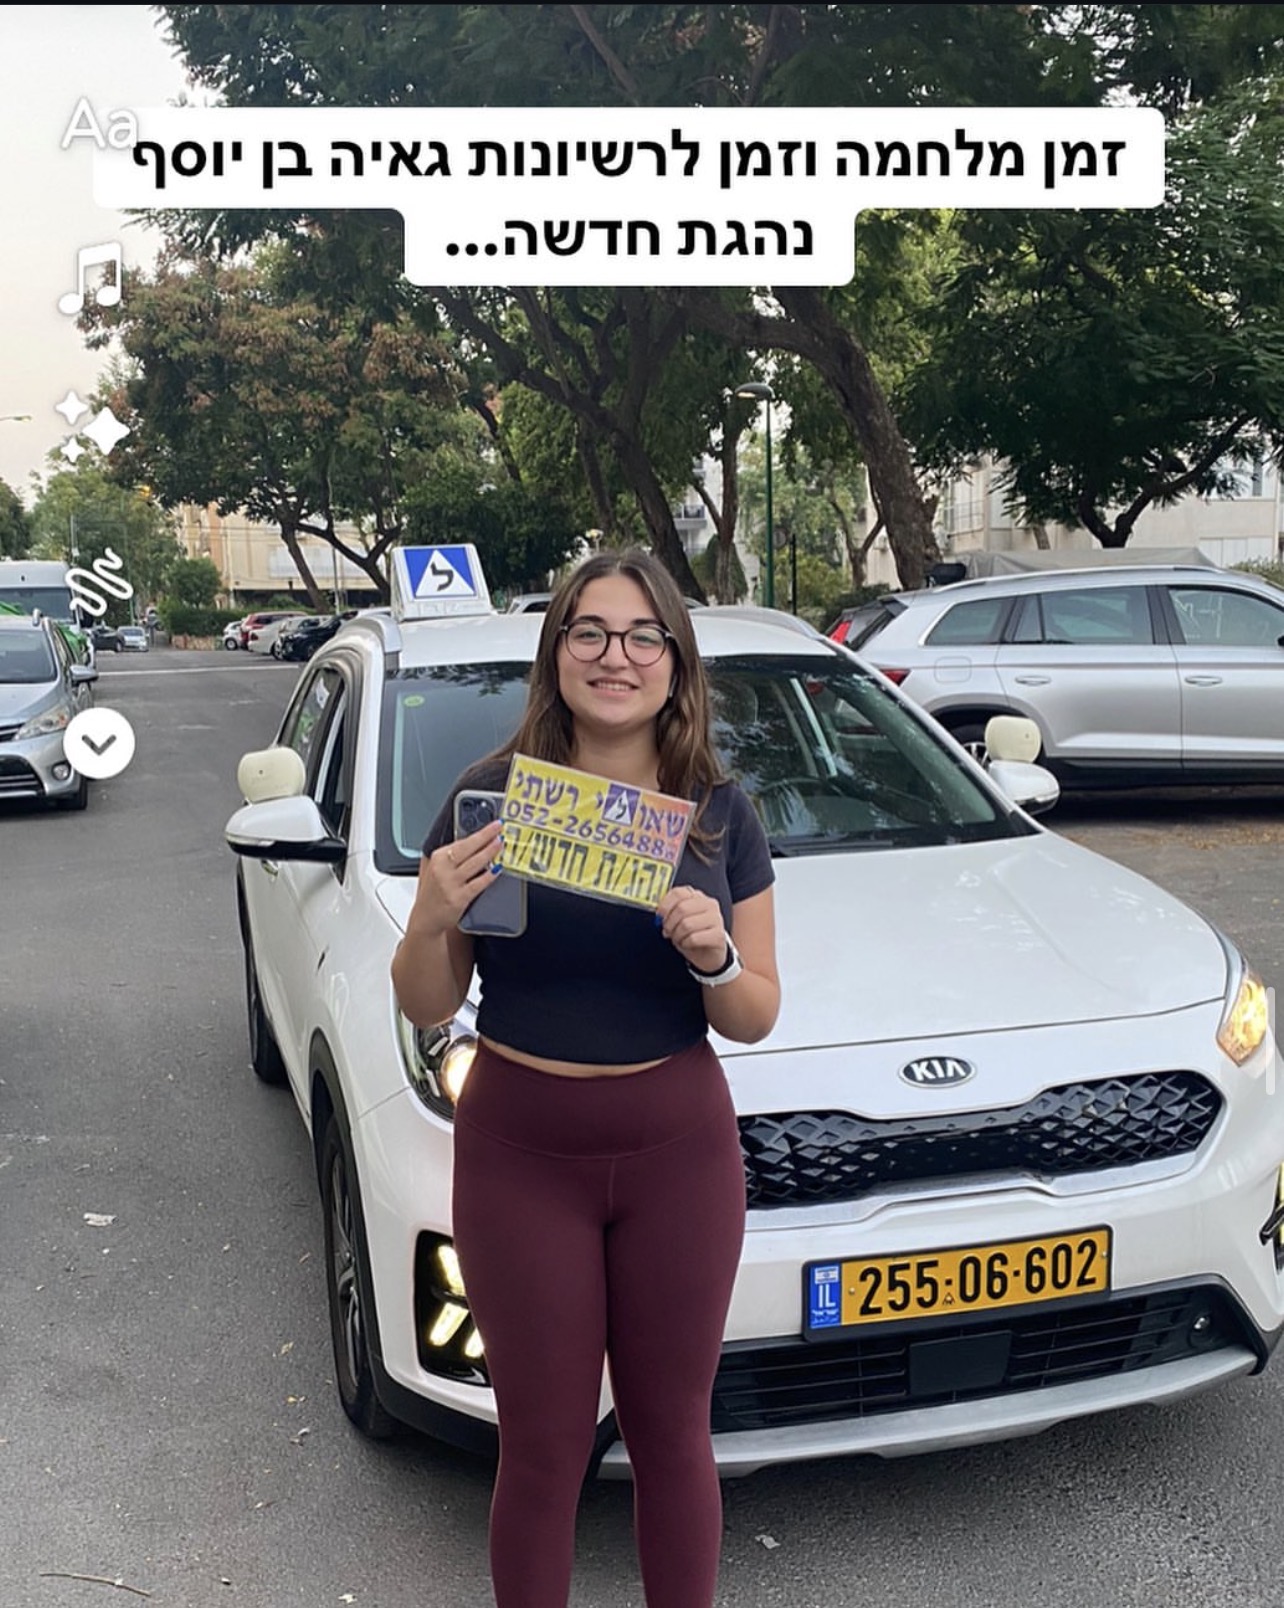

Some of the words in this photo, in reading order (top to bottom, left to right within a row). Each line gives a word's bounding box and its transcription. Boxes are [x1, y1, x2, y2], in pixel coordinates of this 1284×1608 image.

[430, 561, 455, 592] ל
[514, 770, 580, 811] רשתי
[506, 799, 666, 857] 052-2656488
[909, 1059, 967, 1081] KIA
[818, 1283, 837, 1308] IL
